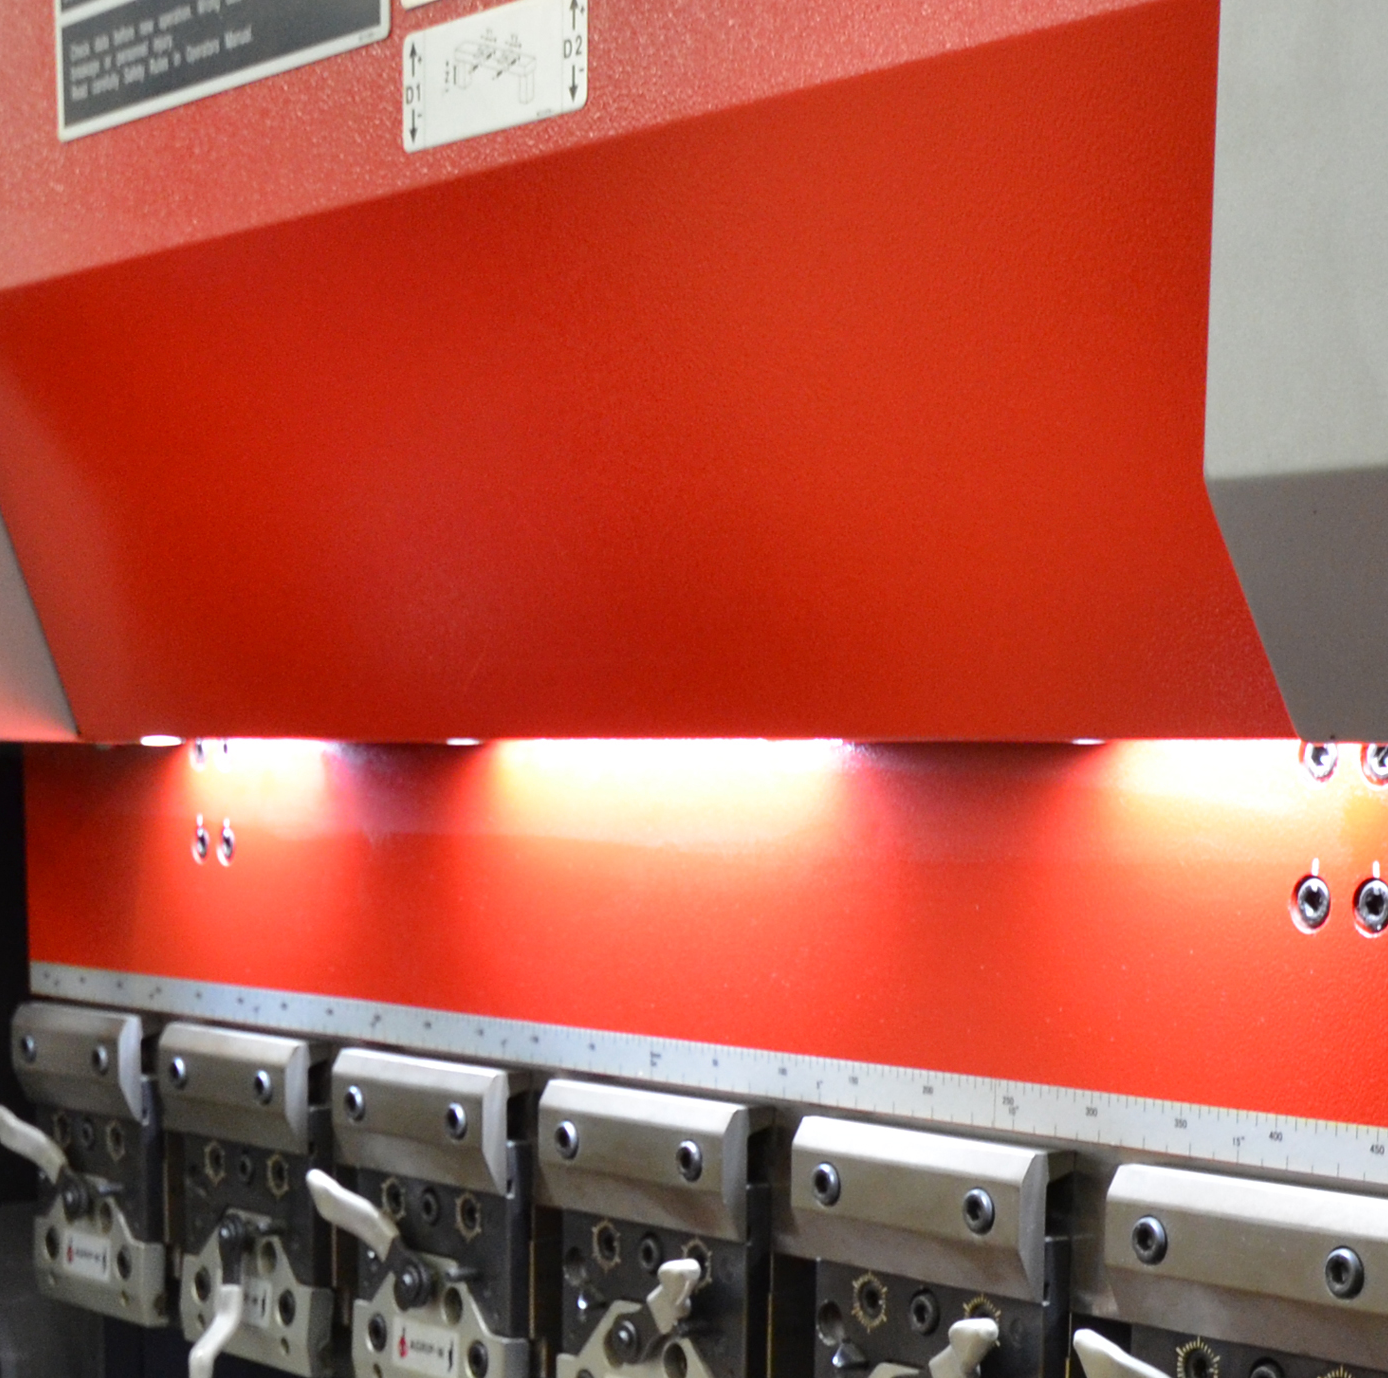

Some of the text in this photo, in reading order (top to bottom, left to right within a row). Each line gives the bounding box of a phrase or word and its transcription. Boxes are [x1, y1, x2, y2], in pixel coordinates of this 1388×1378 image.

[564, 35, 583, 59] D2
[406, 83, 421, 105] D1
[1085, 1106, 1098, 1118] 300
[1174, 1118, 1188, 1130] 350
[1232, 1136, 1245, 1147] 15"
[1268, 1131, 1283, 1143] 400
[1369, 1144, 1385, 1156] 450
